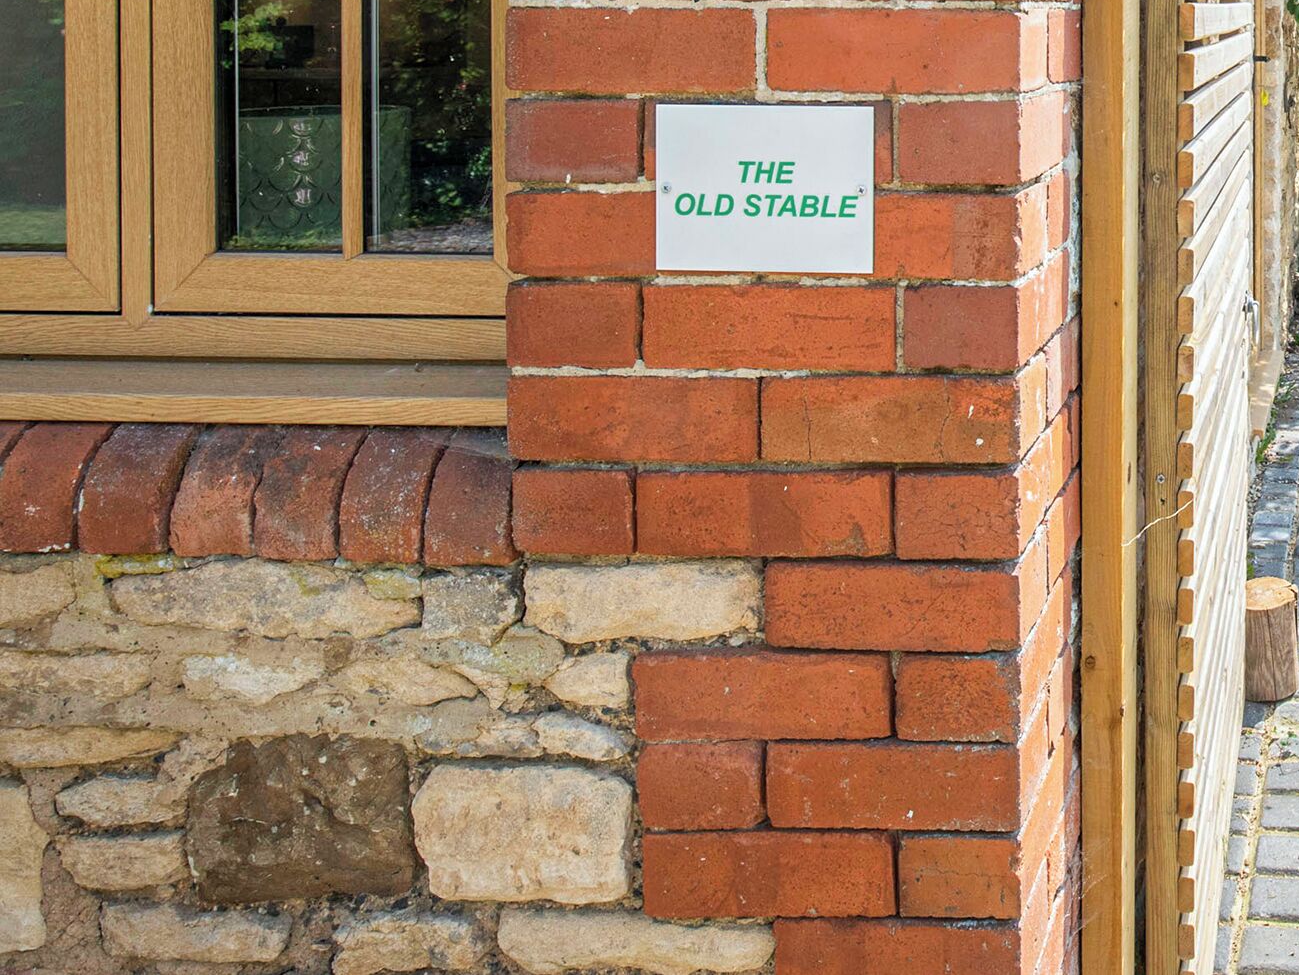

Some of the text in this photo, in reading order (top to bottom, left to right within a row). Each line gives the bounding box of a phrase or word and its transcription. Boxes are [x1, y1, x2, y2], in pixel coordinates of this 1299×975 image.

[738, 161, 796, 184] THE
[674, 193, 859, 218] OLD STABLE
